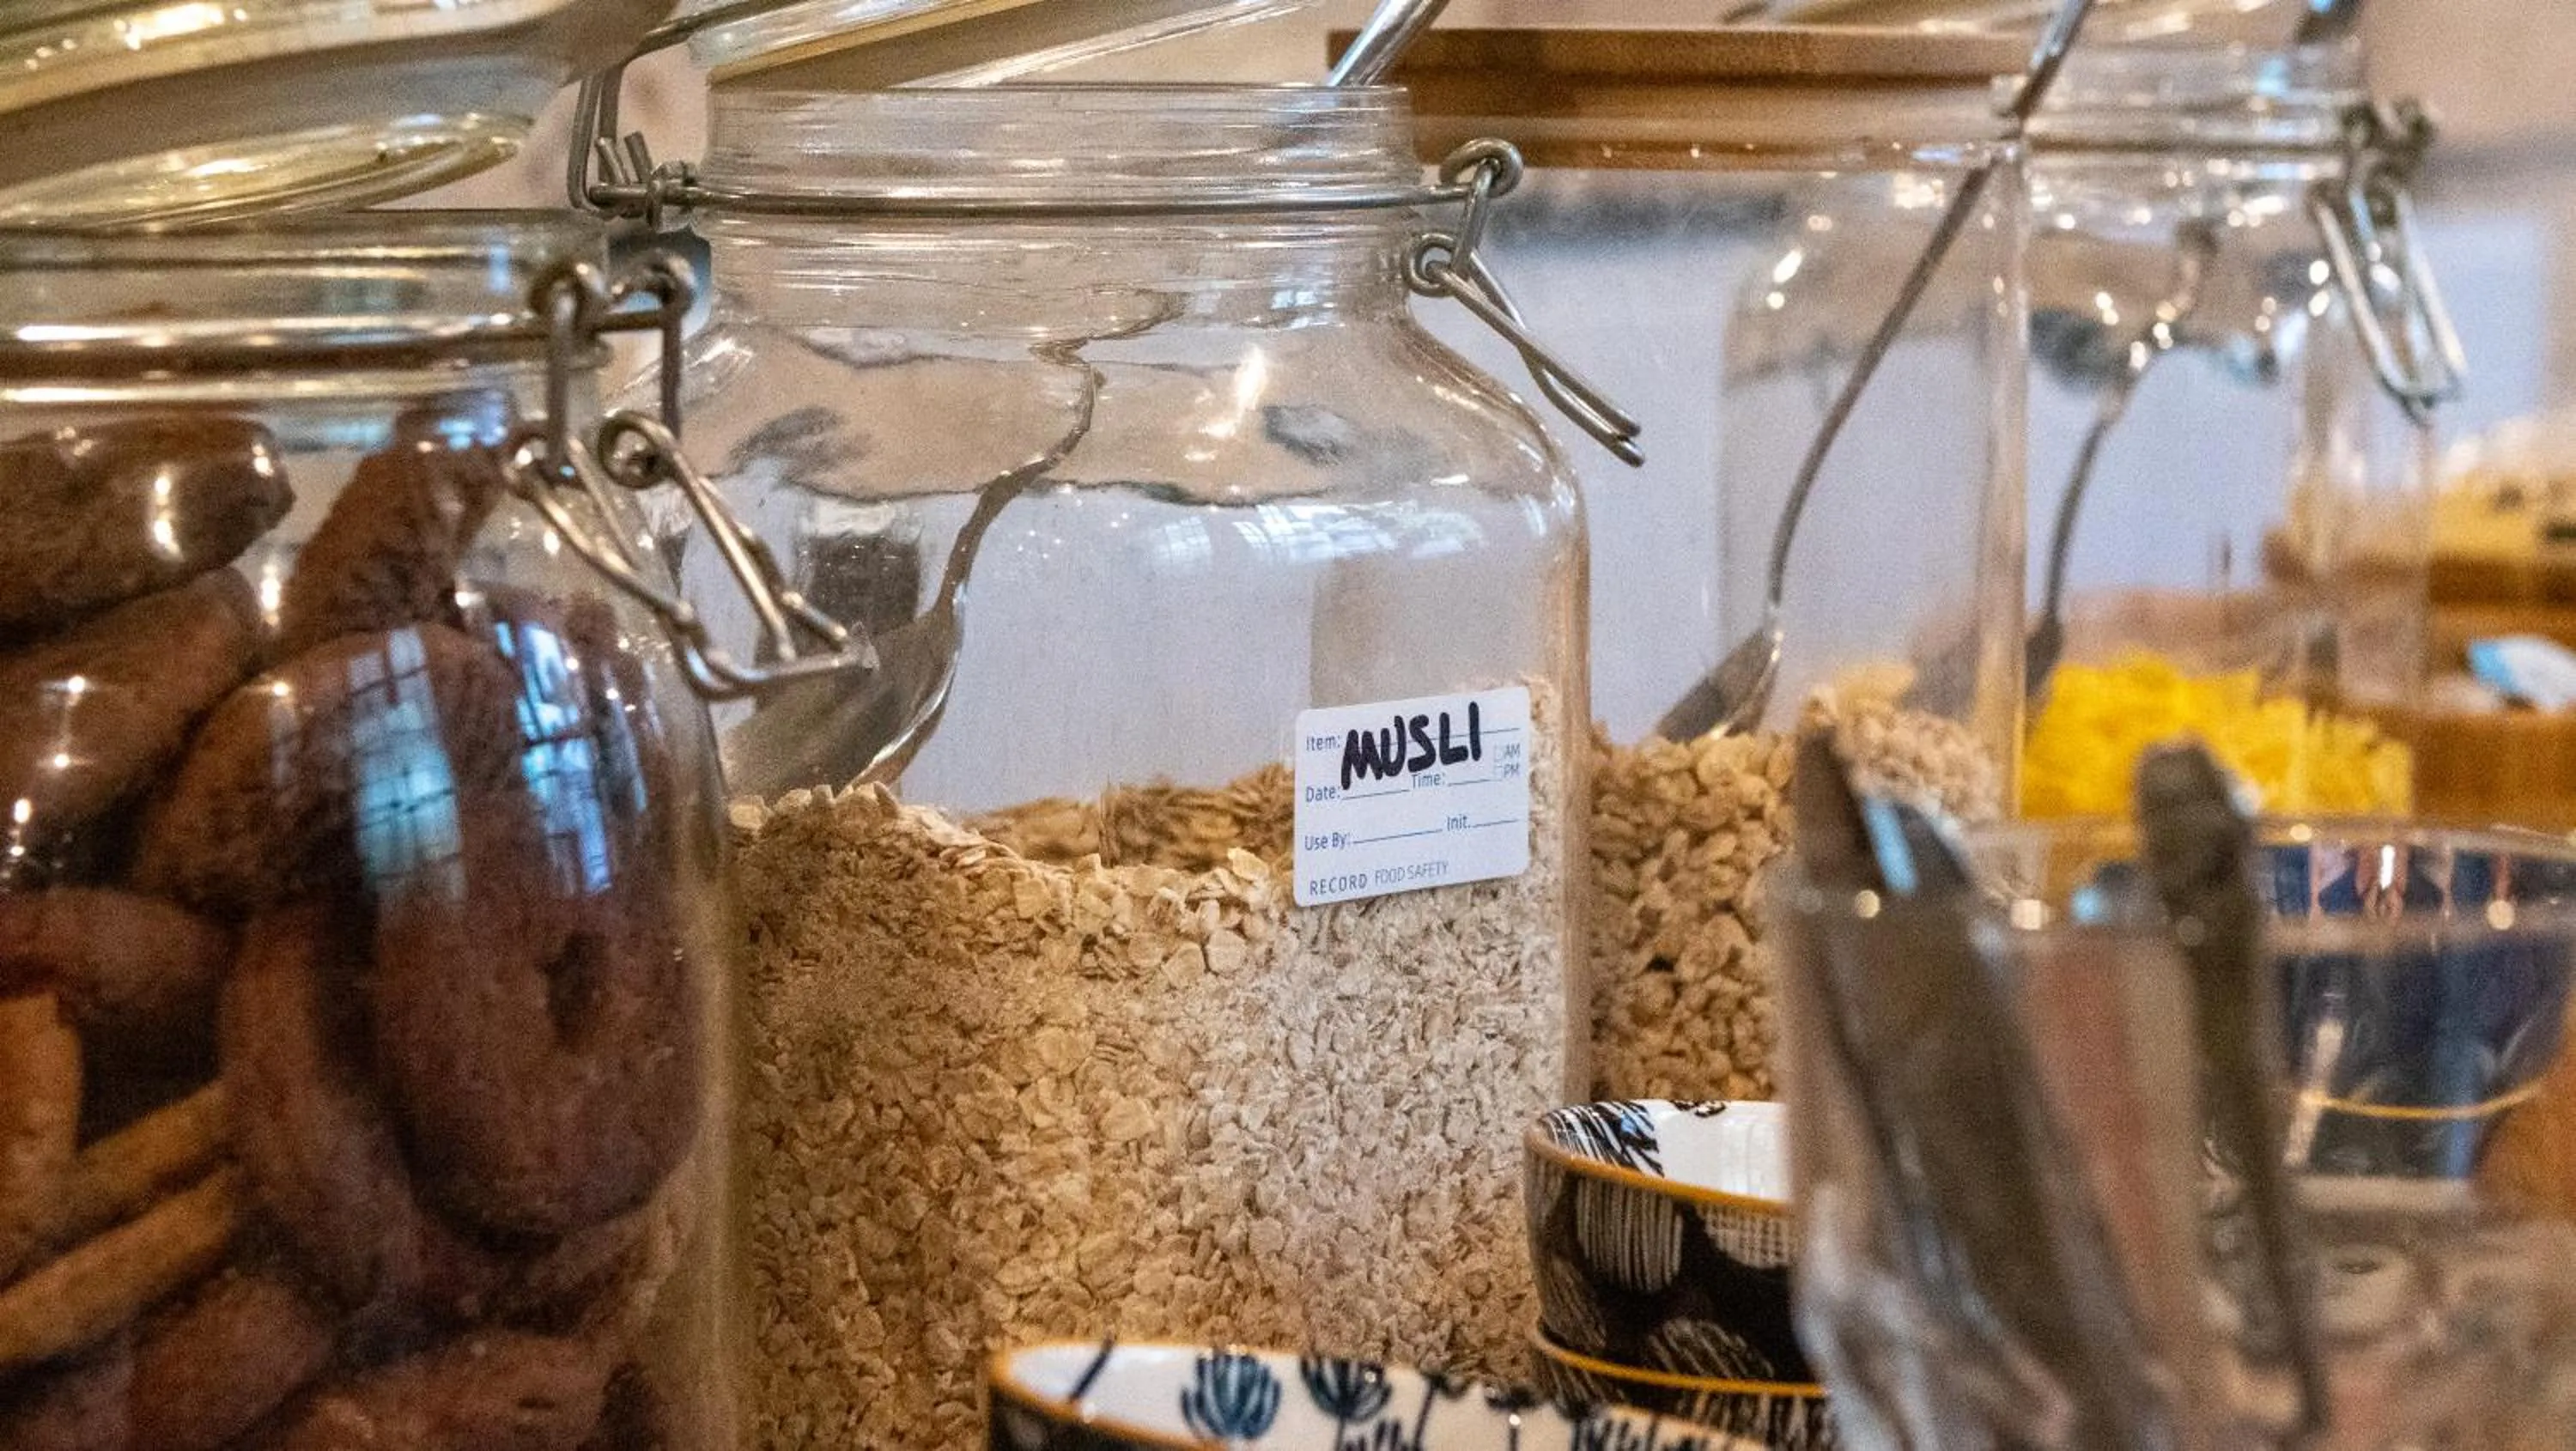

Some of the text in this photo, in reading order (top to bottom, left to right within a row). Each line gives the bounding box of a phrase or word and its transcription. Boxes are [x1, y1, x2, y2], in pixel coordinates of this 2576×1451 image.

[1306, 736, 1341, 752] Item:
[1340, 701, 1481, 790] MUSLI
[1504, 745, 1521, 758] AM
[1504, 764, 1521, 778] PM
[1305, 772, 1446, 803] Date: Time:
[1304, 835, 1328, 851] Use
[1332, 831, 1351, 848] By:
[1309, 859, 1449, 896] RECORD FOOD SAFETY
